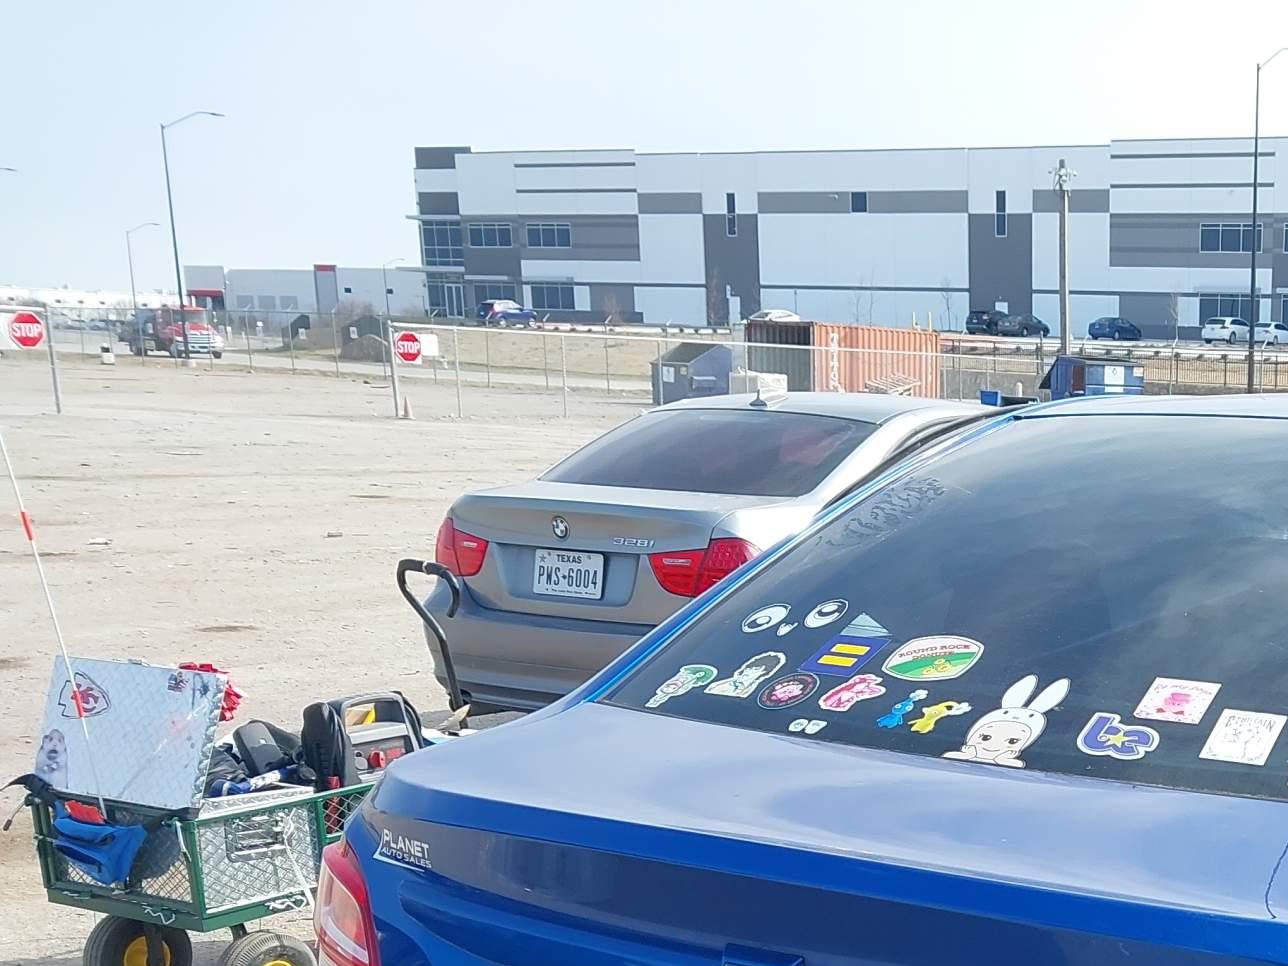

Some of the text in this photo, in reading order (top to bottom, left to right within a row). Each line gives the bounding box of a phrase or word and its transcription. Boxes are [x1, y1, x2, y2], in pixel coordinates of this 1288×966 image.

[12, 322, 42, 337] STOP
[397, 340, 420, 353] STOP
[556, 554, 582, 564] TEXAS
[899, 646, 937, 658] ROUND
[383, 828, 430, 859] PLANET
[380, 846, 432, 869] AUTO SALES
